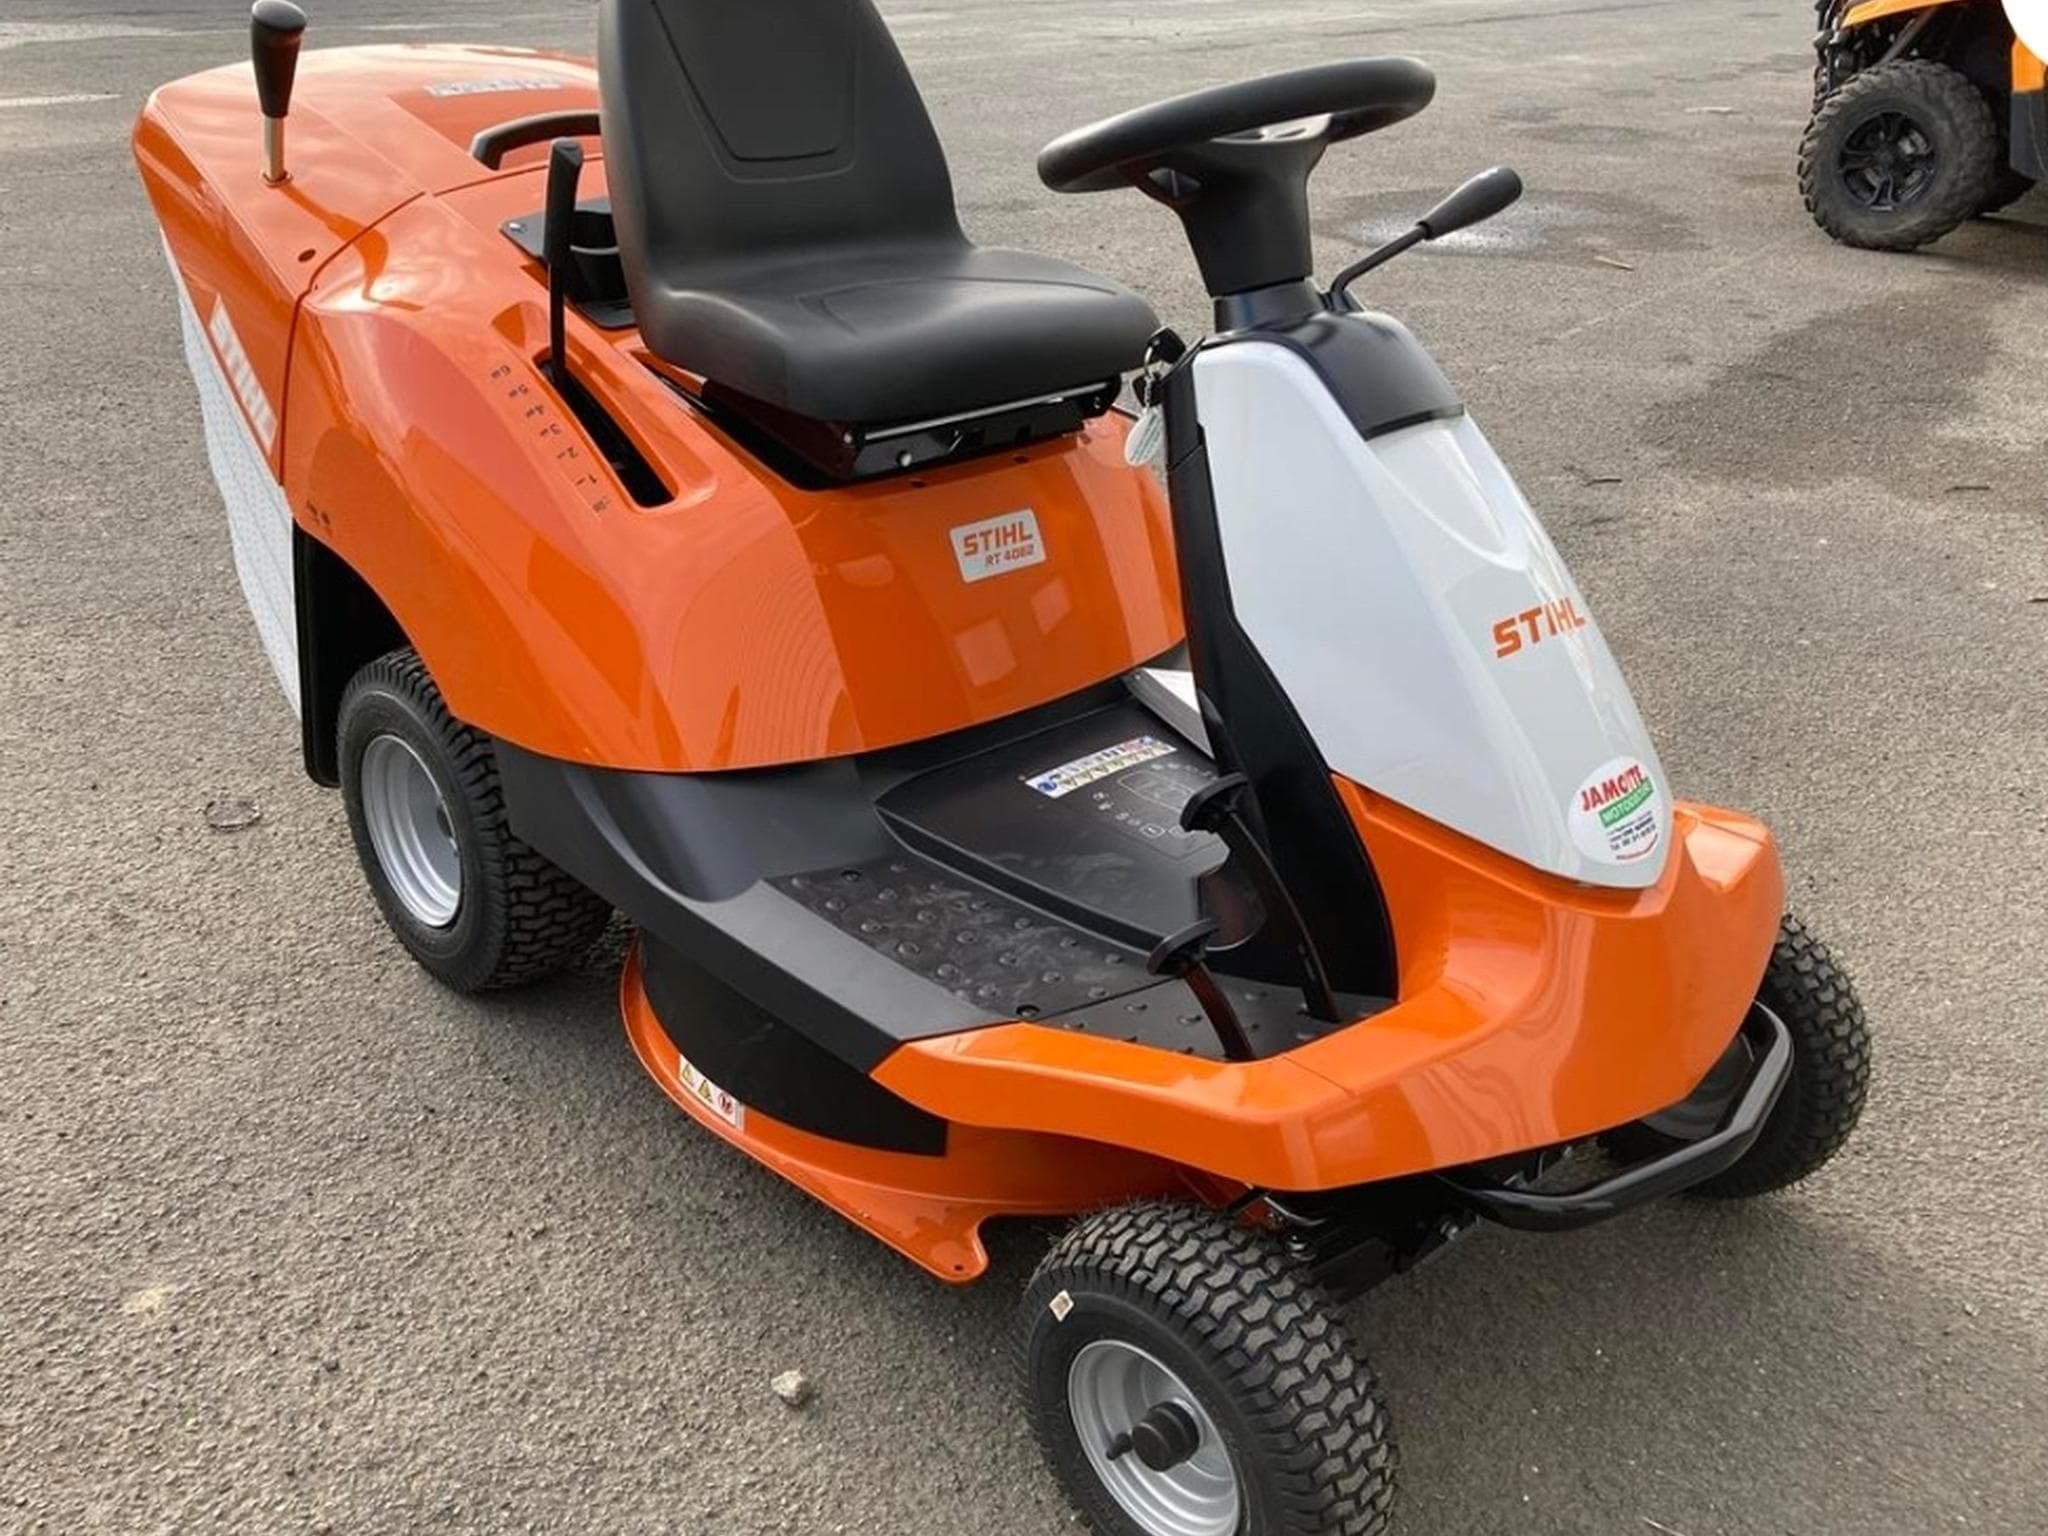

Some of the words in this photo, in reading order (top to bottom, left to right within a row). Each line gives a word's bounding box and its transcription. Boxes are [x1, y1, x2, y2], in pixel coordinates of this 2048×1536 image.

[963, 520, 1034, 557] STIHL
[984, 551, 1001, 566] RT
[1492, 596, 1586, 659] STIHL
